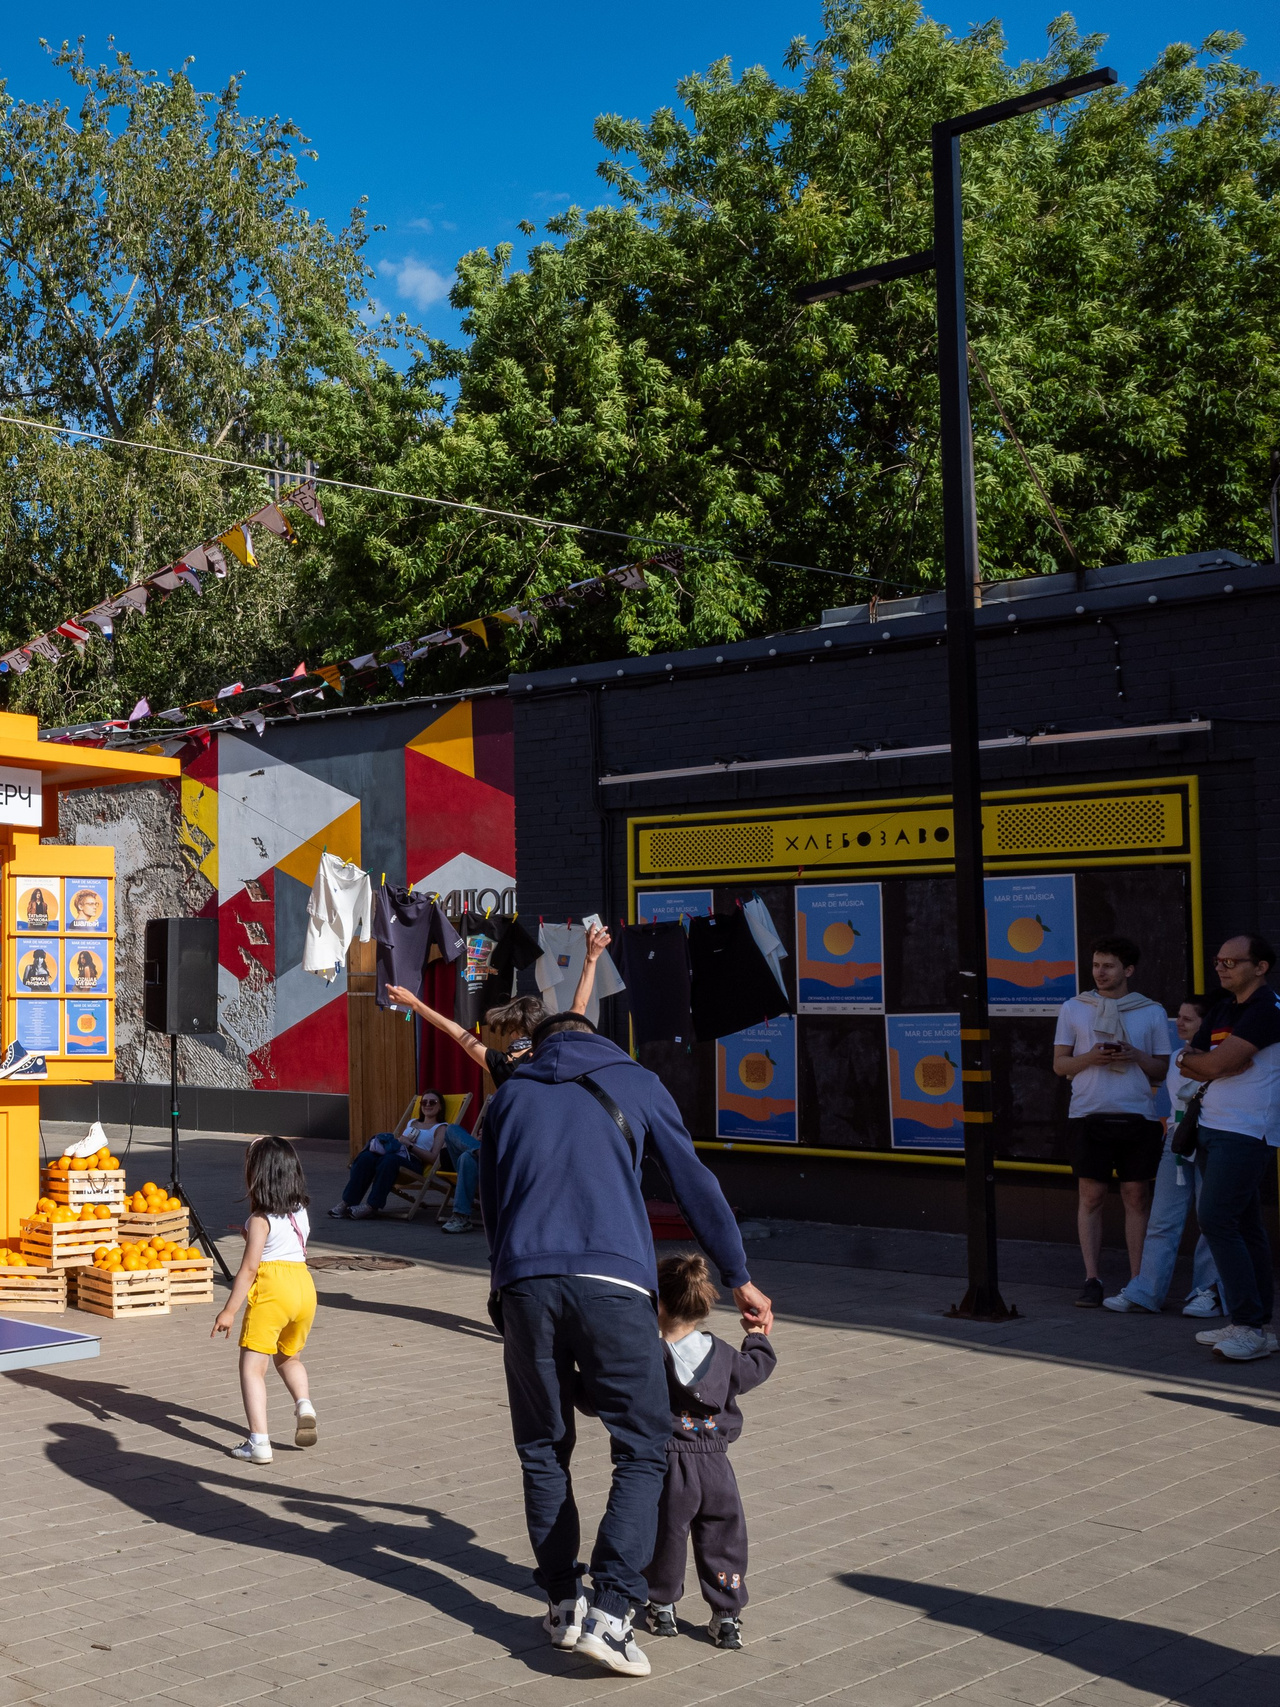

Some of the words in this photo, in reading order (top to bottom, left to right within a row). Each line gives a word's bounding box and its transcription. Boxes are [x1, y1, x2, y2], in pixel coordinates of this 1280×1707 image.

[785, 826, 950, 851] ХЛЕБОЗАВО
[1025, 892, 1055, 902] MÚSICA
[838, 898, 864, 908] MÚSICA
[676, 905, 698, 913] MÚSICA
